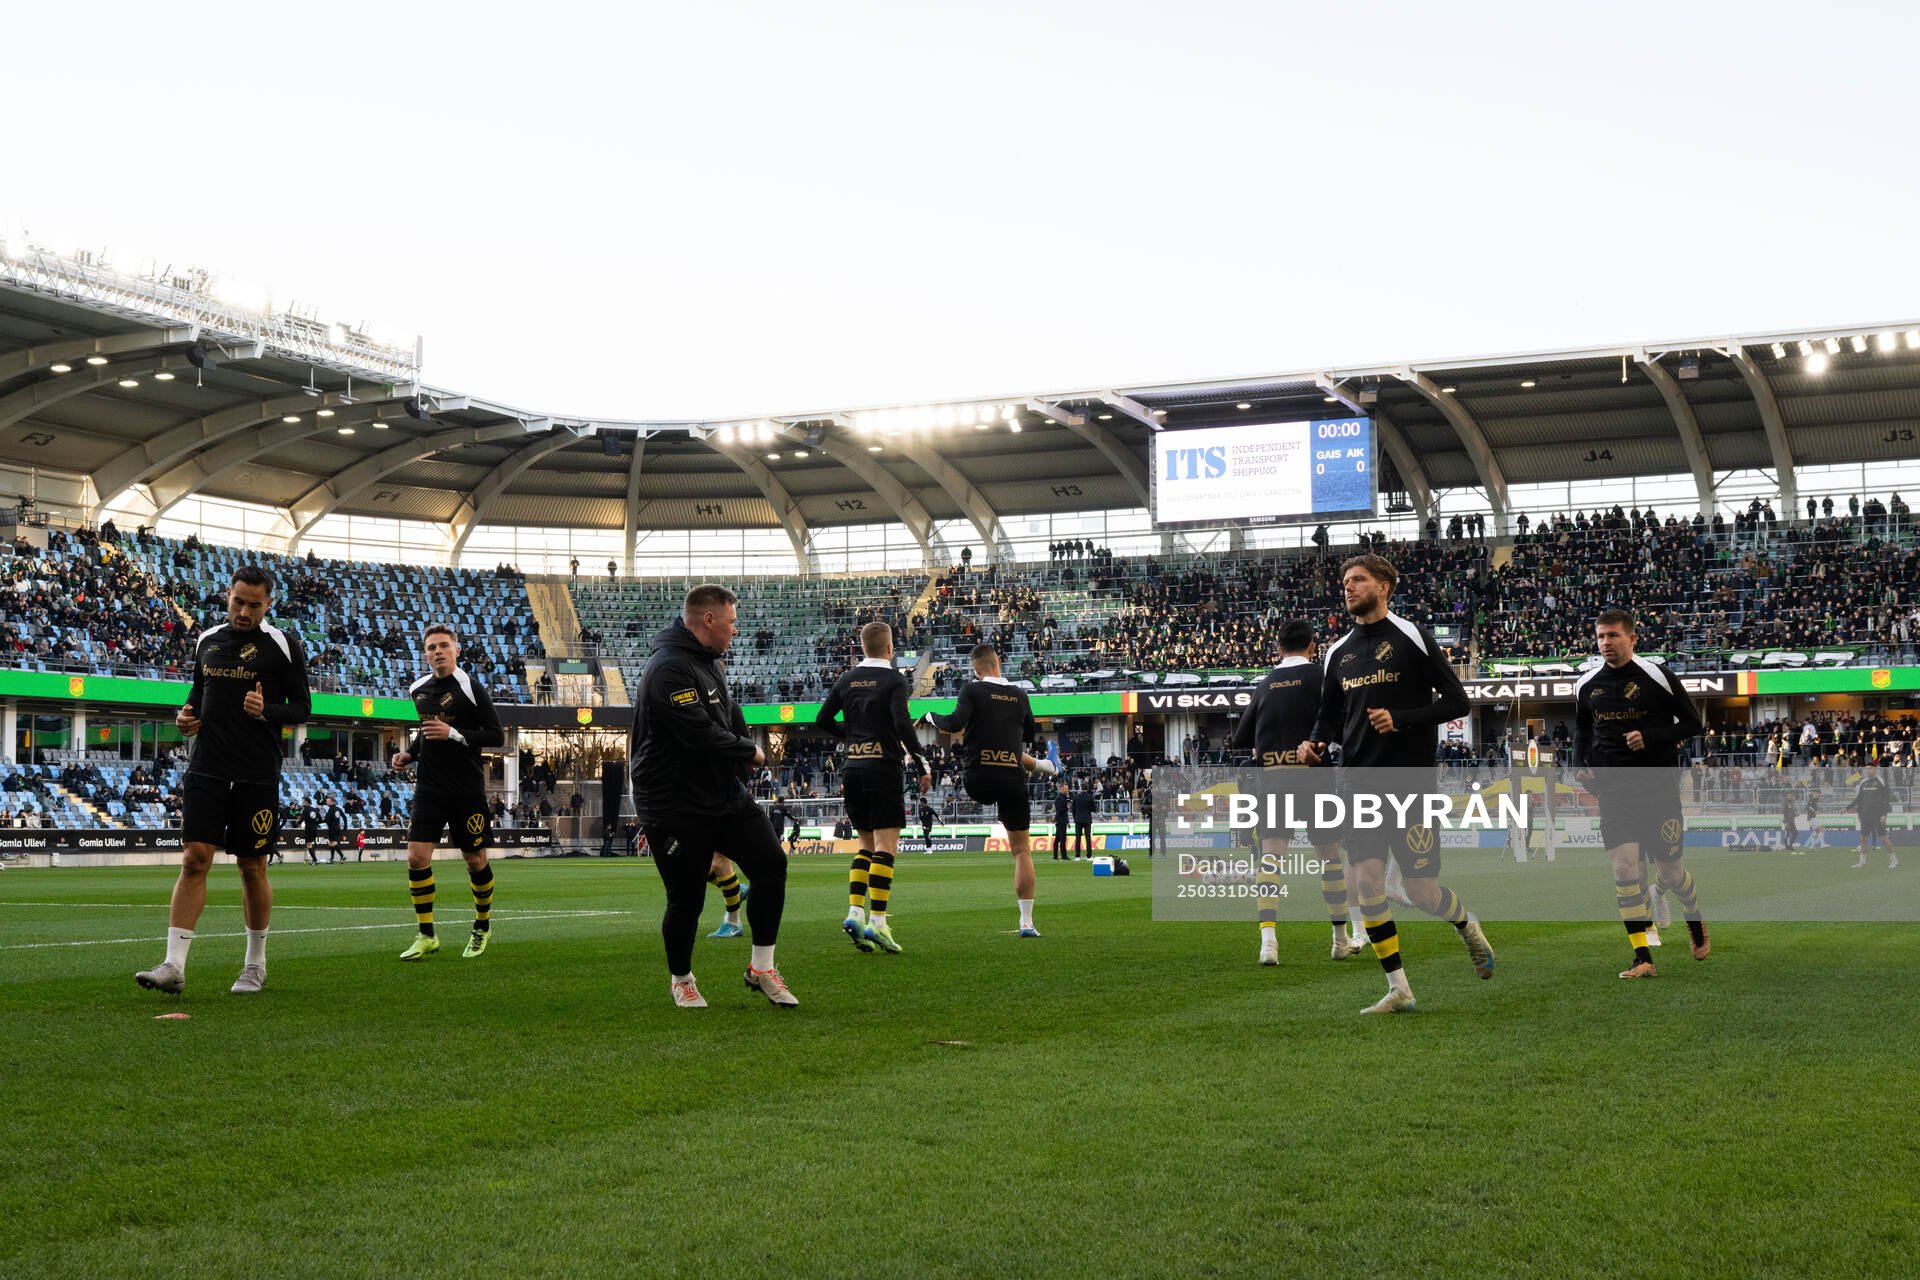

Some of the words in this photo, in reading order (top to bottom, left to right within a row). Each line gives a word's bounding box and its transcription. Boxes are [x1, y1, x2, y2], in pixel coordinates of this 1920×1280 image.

[1318, 422, 1361, 438] 00:00
[1884, 430, 1914, 441] J3
[19, 432, 55, 446] F3
[1231, 441, 1302, 455] INDEPENDENT
[1316, 450, 1341, 460] GAIS
[1346, 448, 1365, 458] AIK
[1231, 454, 1289, 466] TRANSPORT
[1584, 450, 1614, 461] J4
[1164, 446, 1227, 481] ITS
[1316, 464, 1325, 475] 0
[1356, 461, 1365, 472] 0
[1231, 466, 1277, 477] SHIPPING
[1052, 486, 1082, 497] H3
[696, 503, 723, 515] H1
[835, 499, 867, 512] H2
[202, 664, 258, 680] truecaller
[1342, 670, 1401, 691] truecaller
[1148, 695, 1173, 708] VI
[1177, 693, 1231, 707] SKA
[1541, 683, 1548, 697] I
[981, 750, 1017, 763] SVEA
[1262, 750, 1297, 766] SVE
[24, 838, 46, 847] Ullevi
[79, 838, 103, 847] Gamla
[104, 837, 126, 847] Ullevi
[156, 837, 179, 846] Gamla
[376, 836, 393, 845] Ullevi
[520, 835, 536, 843] Gamla
